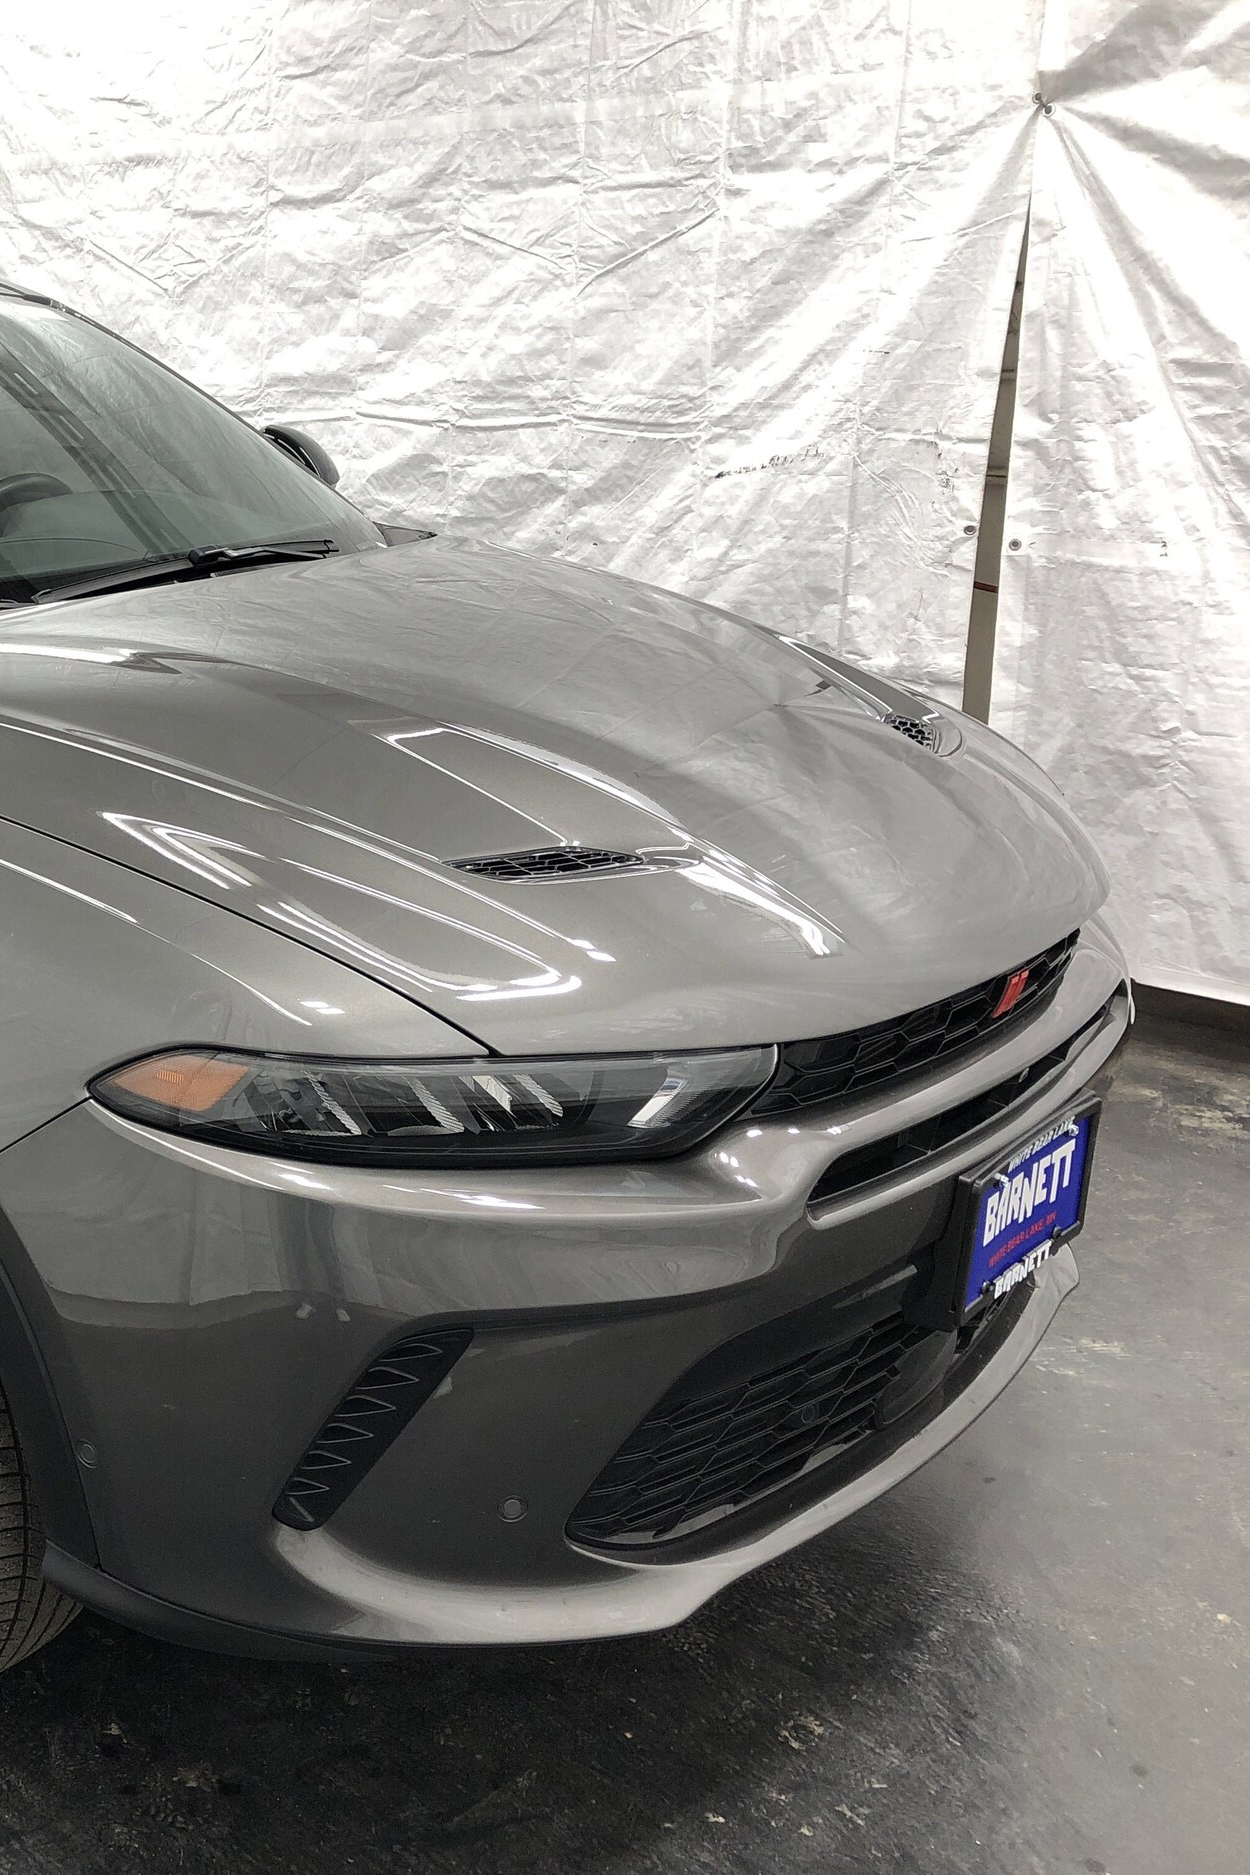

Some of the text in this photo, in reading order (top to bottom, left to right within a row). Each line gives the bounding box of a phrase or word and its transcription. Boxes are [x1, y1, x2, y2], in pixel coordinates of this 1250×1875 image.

[1032, 1130, 1054, 1155] BEAR
[983, 1139, 1076, 1247] BARNETT
[993, 1239, 1054, 1299] BARNETT
